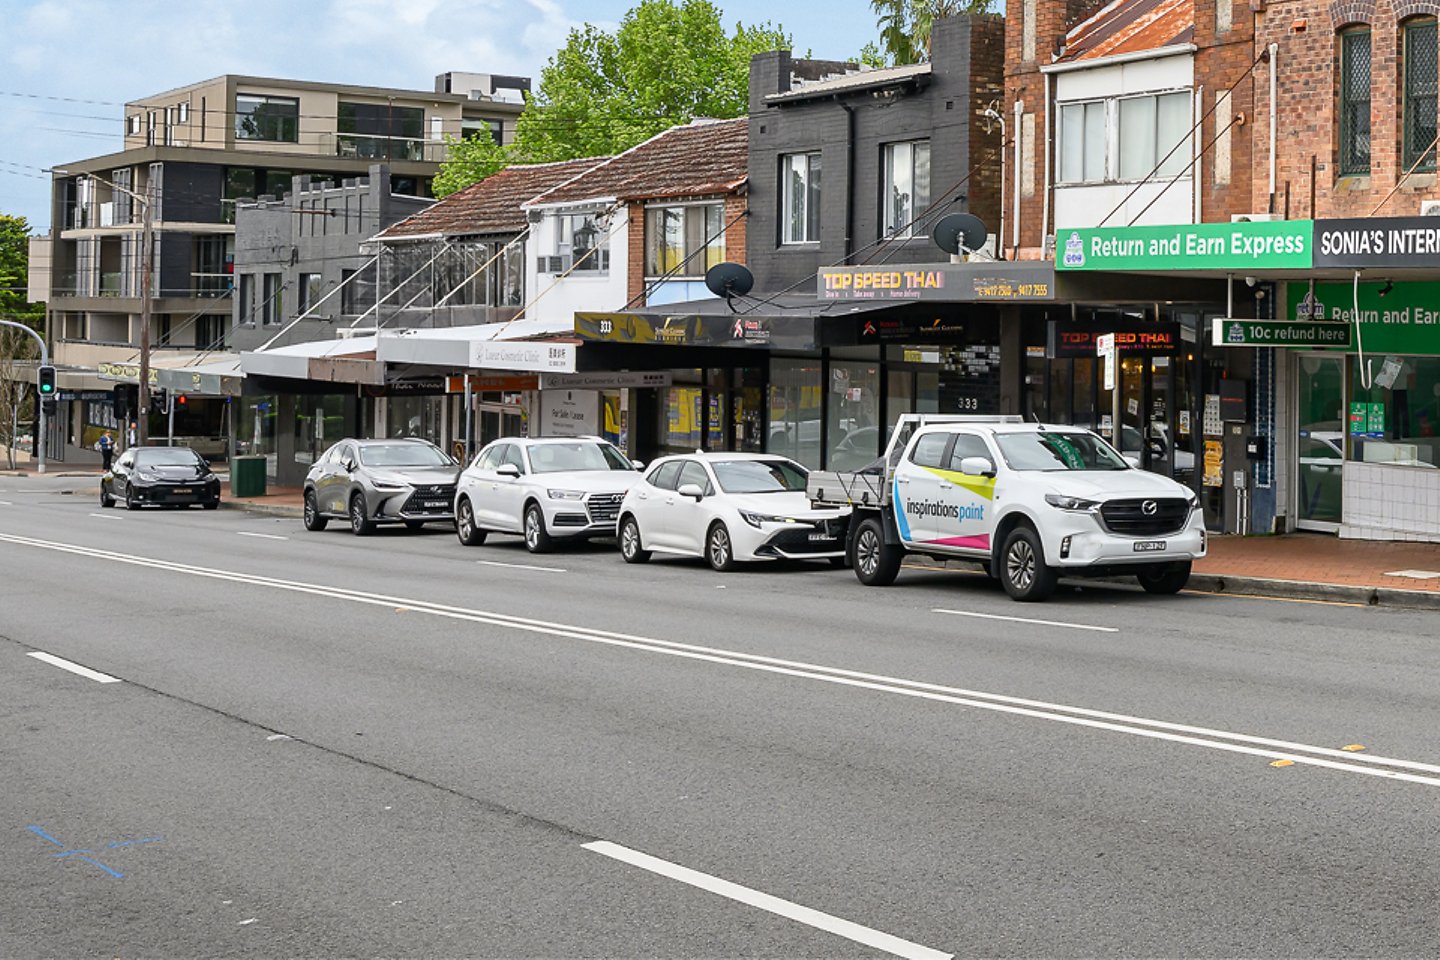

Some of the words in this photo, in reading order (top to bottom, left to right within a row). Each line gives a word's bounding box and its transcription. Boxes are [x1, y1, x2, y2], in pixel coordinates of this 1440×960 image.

[1091, 236, 1144, 257] Return
[1148, 234, 1181, 256] and
[1185, 234, 1225, 255] Earn
[1231, 232, 1304, 258] Express
[1321, 230, 1384, 255] SONIA'S
[823, 273, 852, 289] TOP
[853, 272, 901, 289] SPEED
[904, 271, 944, 288] THAI
[1332, 307, 1378, 324] Return
[1382, 307, 1409, 324] and
[600, 320, 613, 334] 333
[1249, 325, 1271, 339] 10c
[1274, 326, 1314, 340] refund
[1318, 327, 1345, 341] here
[1061, 333, 1089, 343] TOP
[1138, 333, 1169, 343] THAI
[958, 398, 978, 410] 333
[907, 497, 958, 519] inspirations
[959, 502, 985, 523] paint
